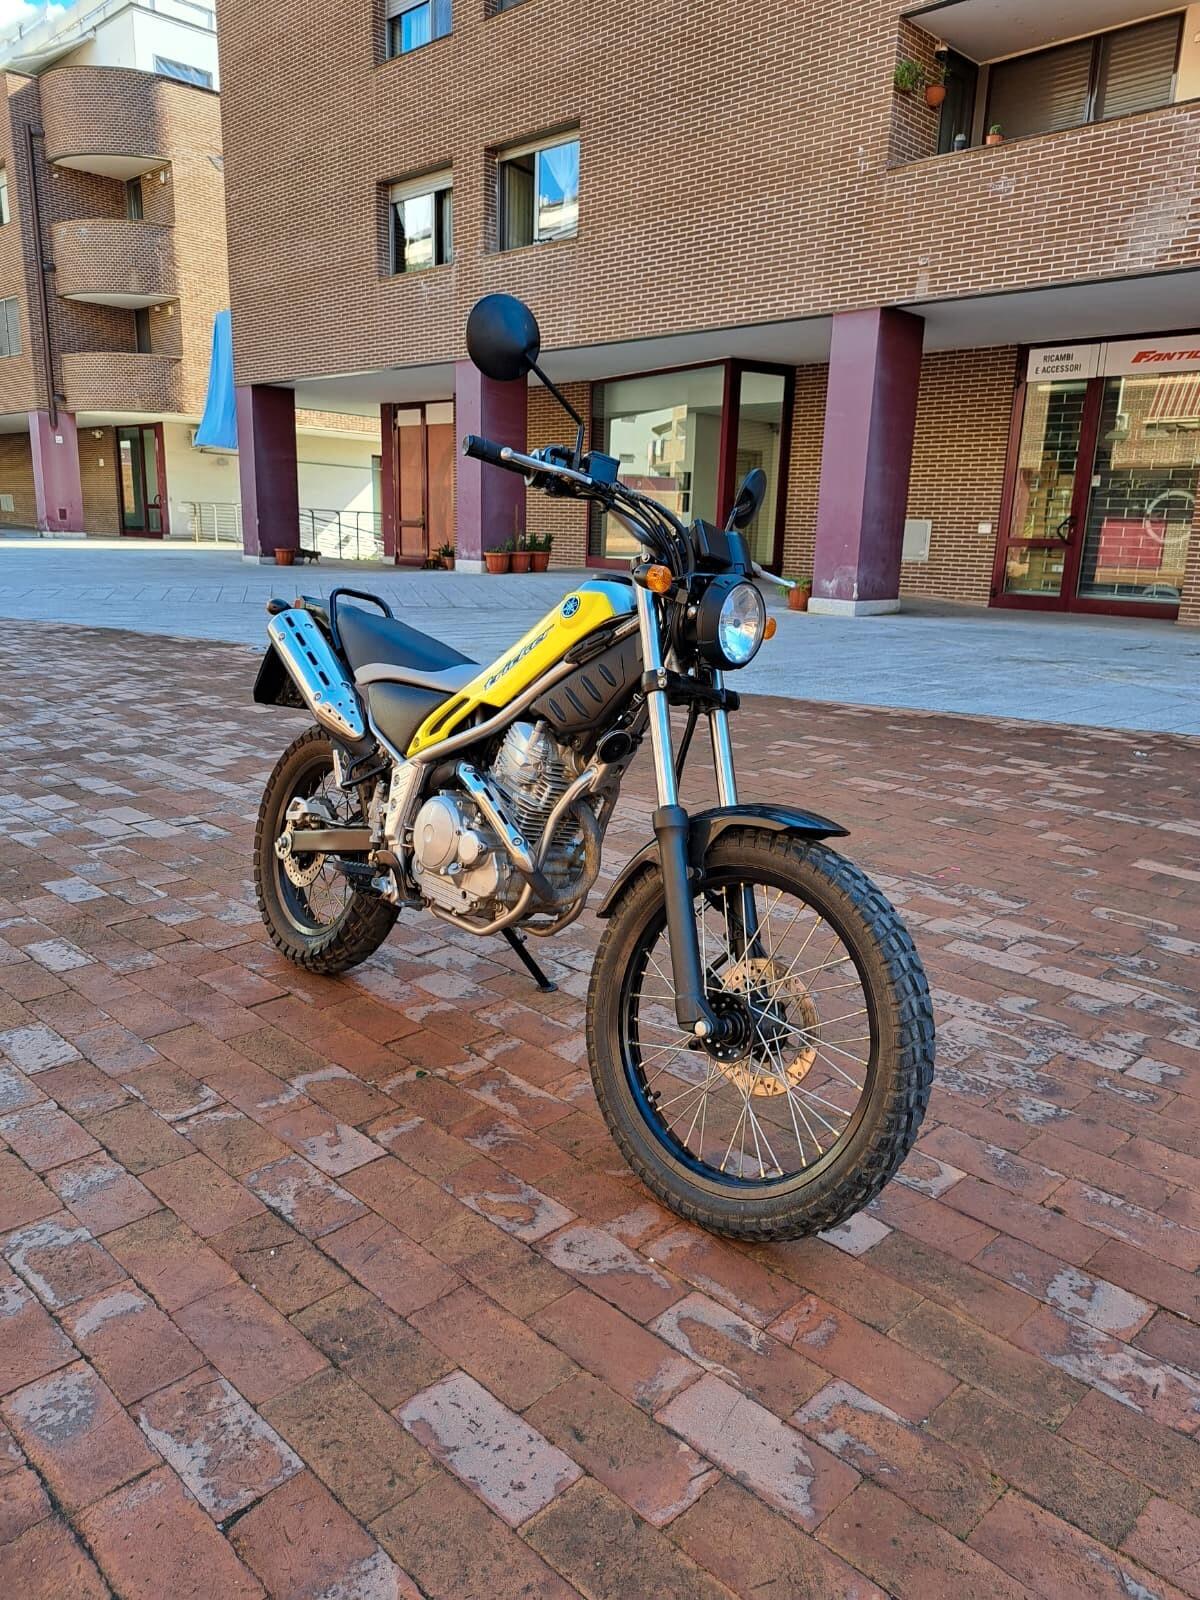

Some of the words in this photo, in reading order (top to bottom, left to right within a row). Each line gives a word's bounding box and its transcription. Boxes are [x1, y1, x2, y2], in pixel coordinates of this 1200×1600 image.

[1043, 353, 1074, 363] RICAMBI
[1035, 367, 1040, 375] E
[1042, 364, 1082, 374] ACCESSORI
